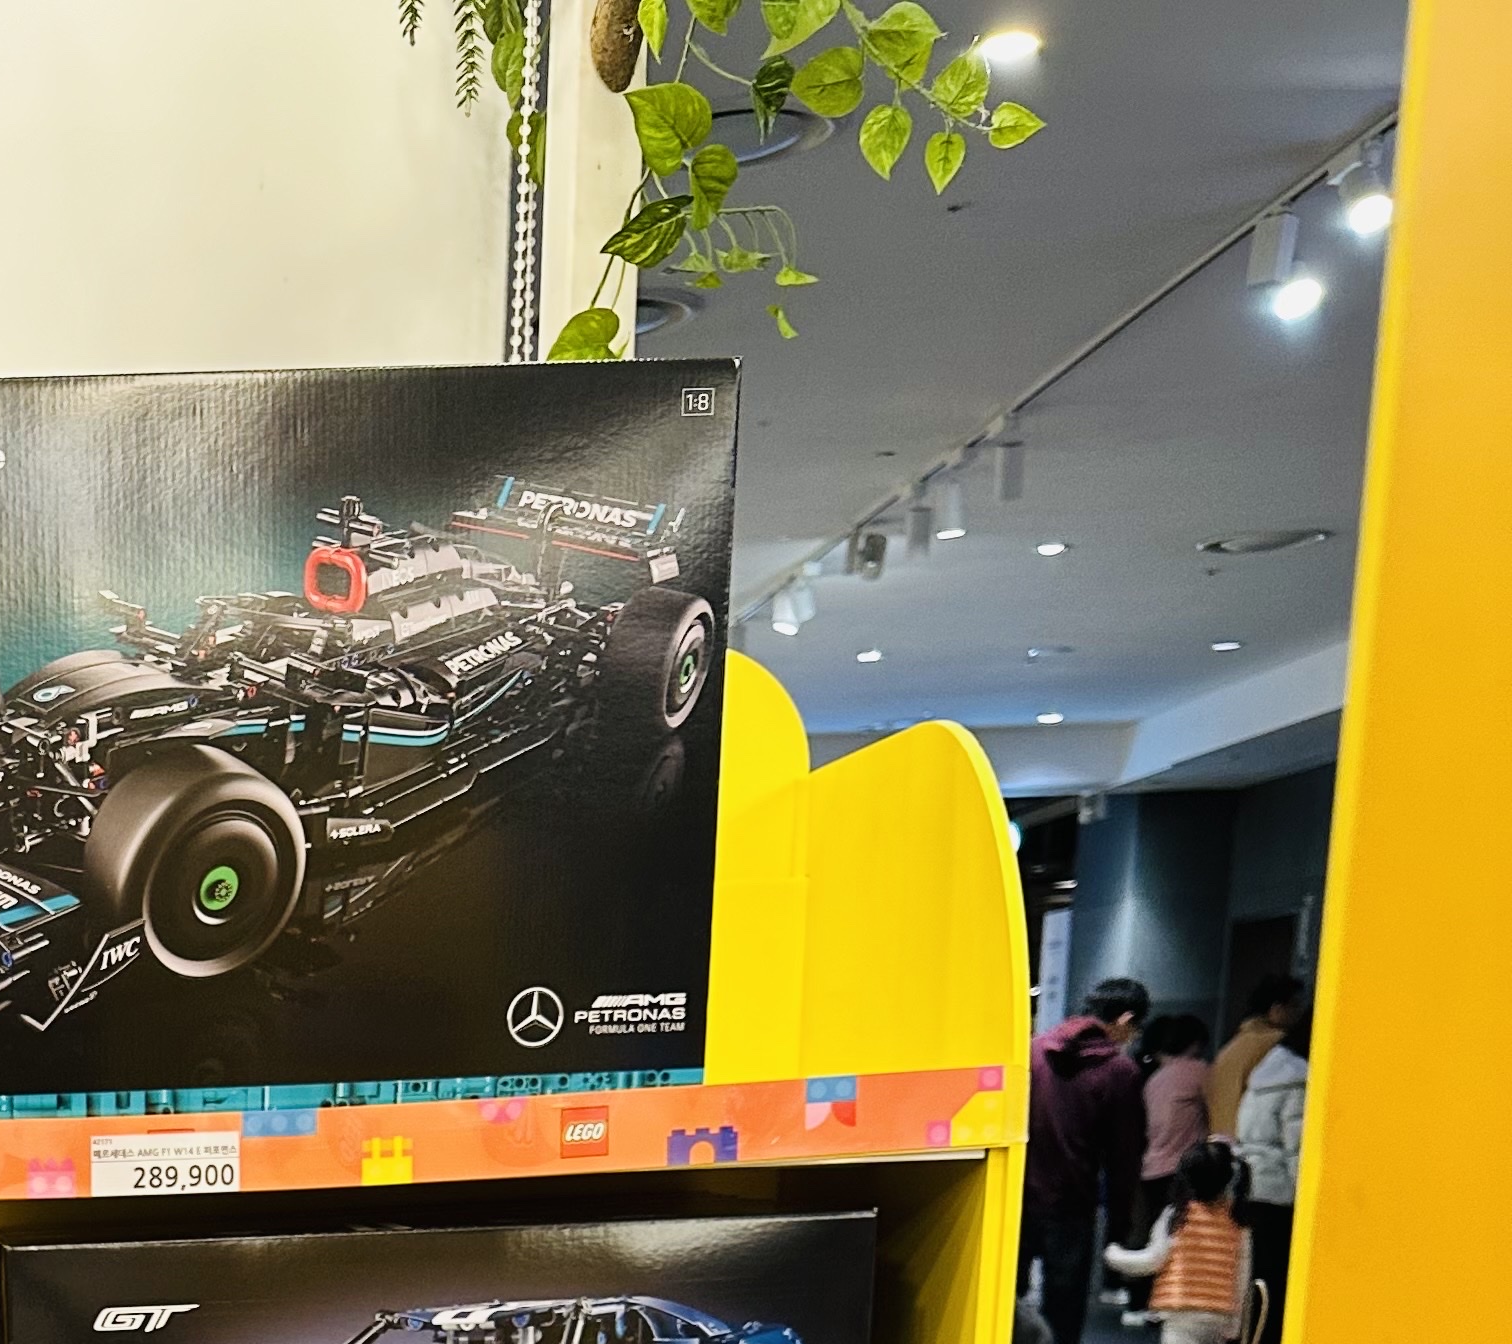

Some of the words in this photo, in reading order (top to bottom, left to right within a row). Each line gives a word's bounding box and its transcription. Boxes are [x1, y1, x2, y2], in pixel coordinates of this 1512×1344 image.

[686, 393, 709, 411] 1:8
[518, 490, 637, 528] PETRONAS
[444, 630, 523, 676] PETRONAS
[99, 936, 141, 971] IWC
[624, 991, 687, 1008] AMG
[573, 1006, 687, 1024] PETRONAS
[588, 1023, 636, 1035] FORMULA
[636, 1022, 657, 1033] ONE
[659, 1021, 686, 1032] TEAM
[563, 1119, 606, 1143] LEGO
[138, 1146, 160, 1158] AMG
[133, 1163, 235, 1191] 289,900
[92, 1303, 201, 1334] GT
